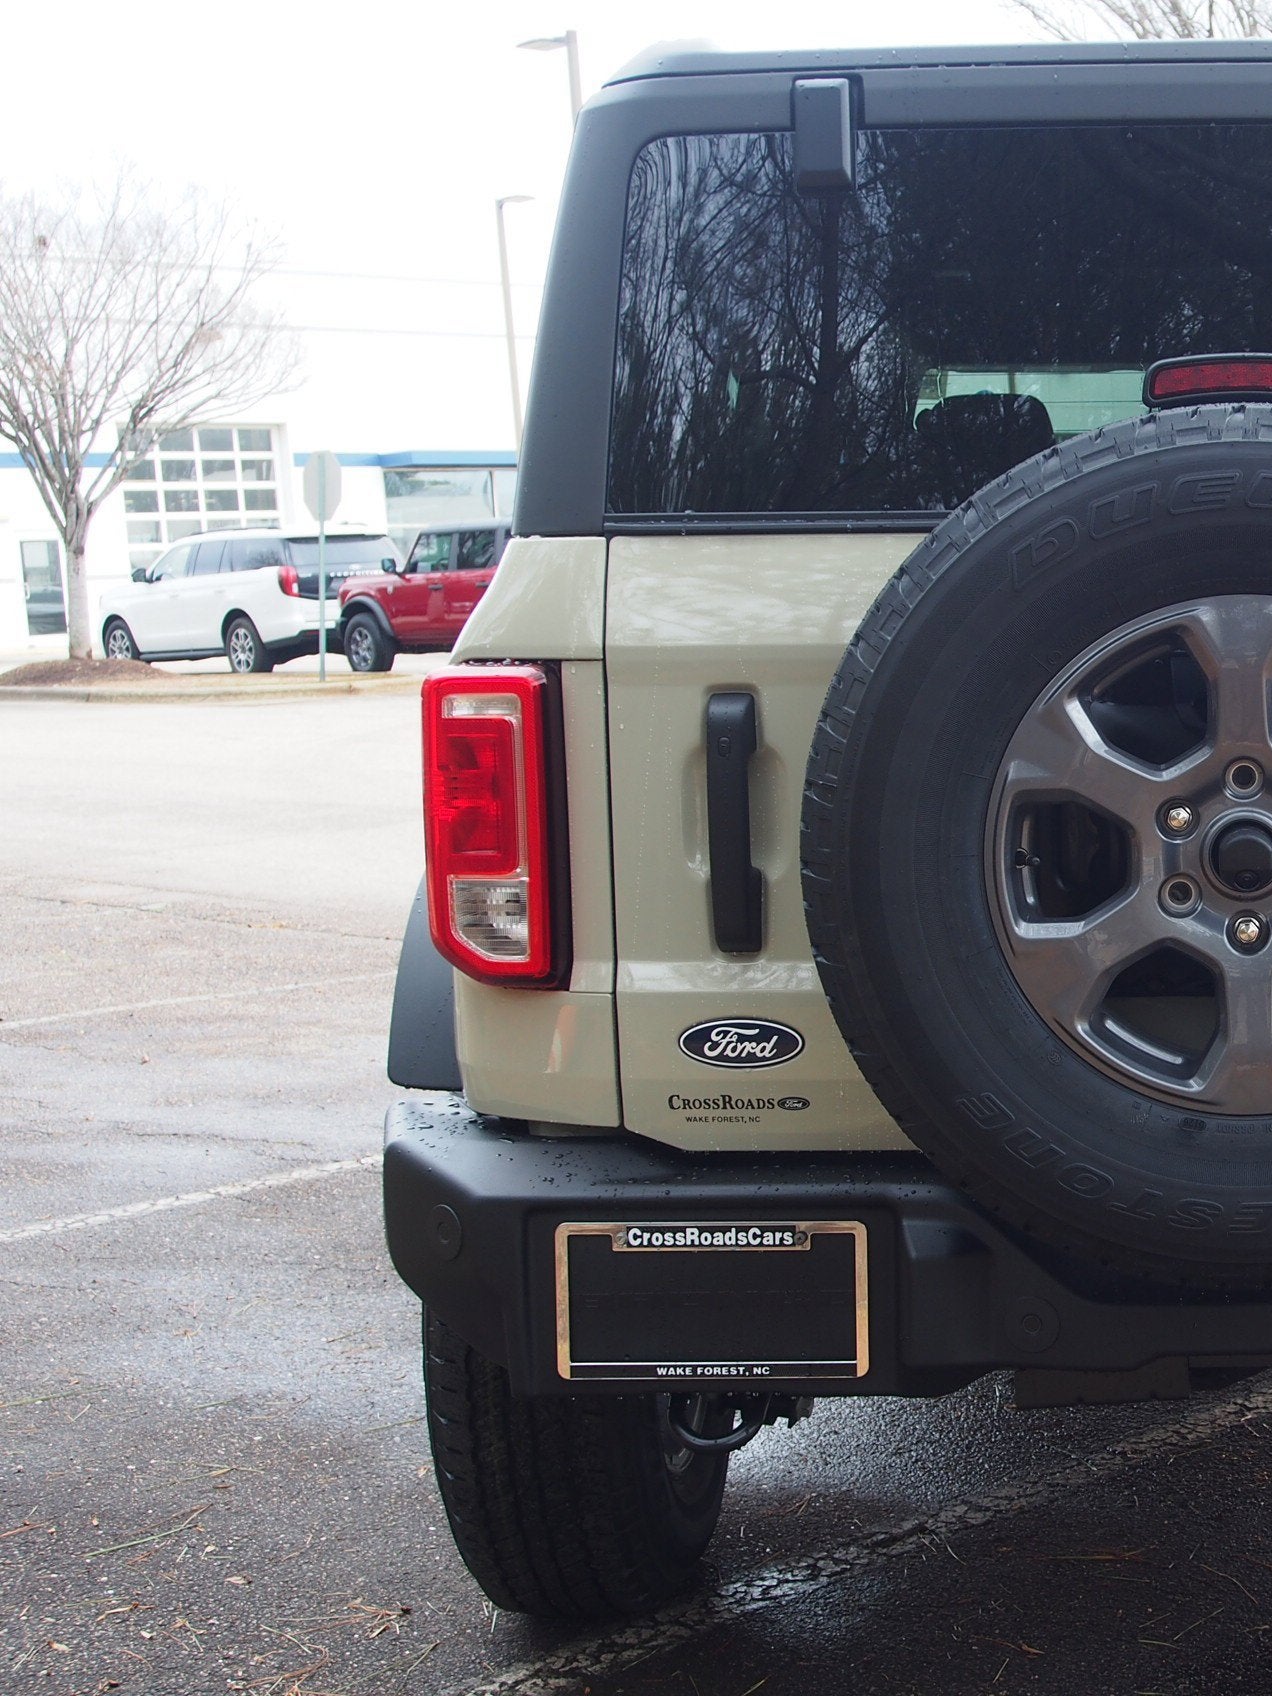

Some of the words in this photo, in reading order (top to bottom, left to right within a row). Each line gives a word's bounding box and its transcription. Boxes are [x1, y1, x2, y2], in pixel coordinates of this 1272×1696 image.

[703, 1026, 779, 1057] Ford
[627, 1227, 794, 1246] CrossRoadsCars
[657, 1367, 692, 1375] WAKE
[697, 1367, 749, 1376] FOREST,
[753, 1367, 770, 1375] NC
